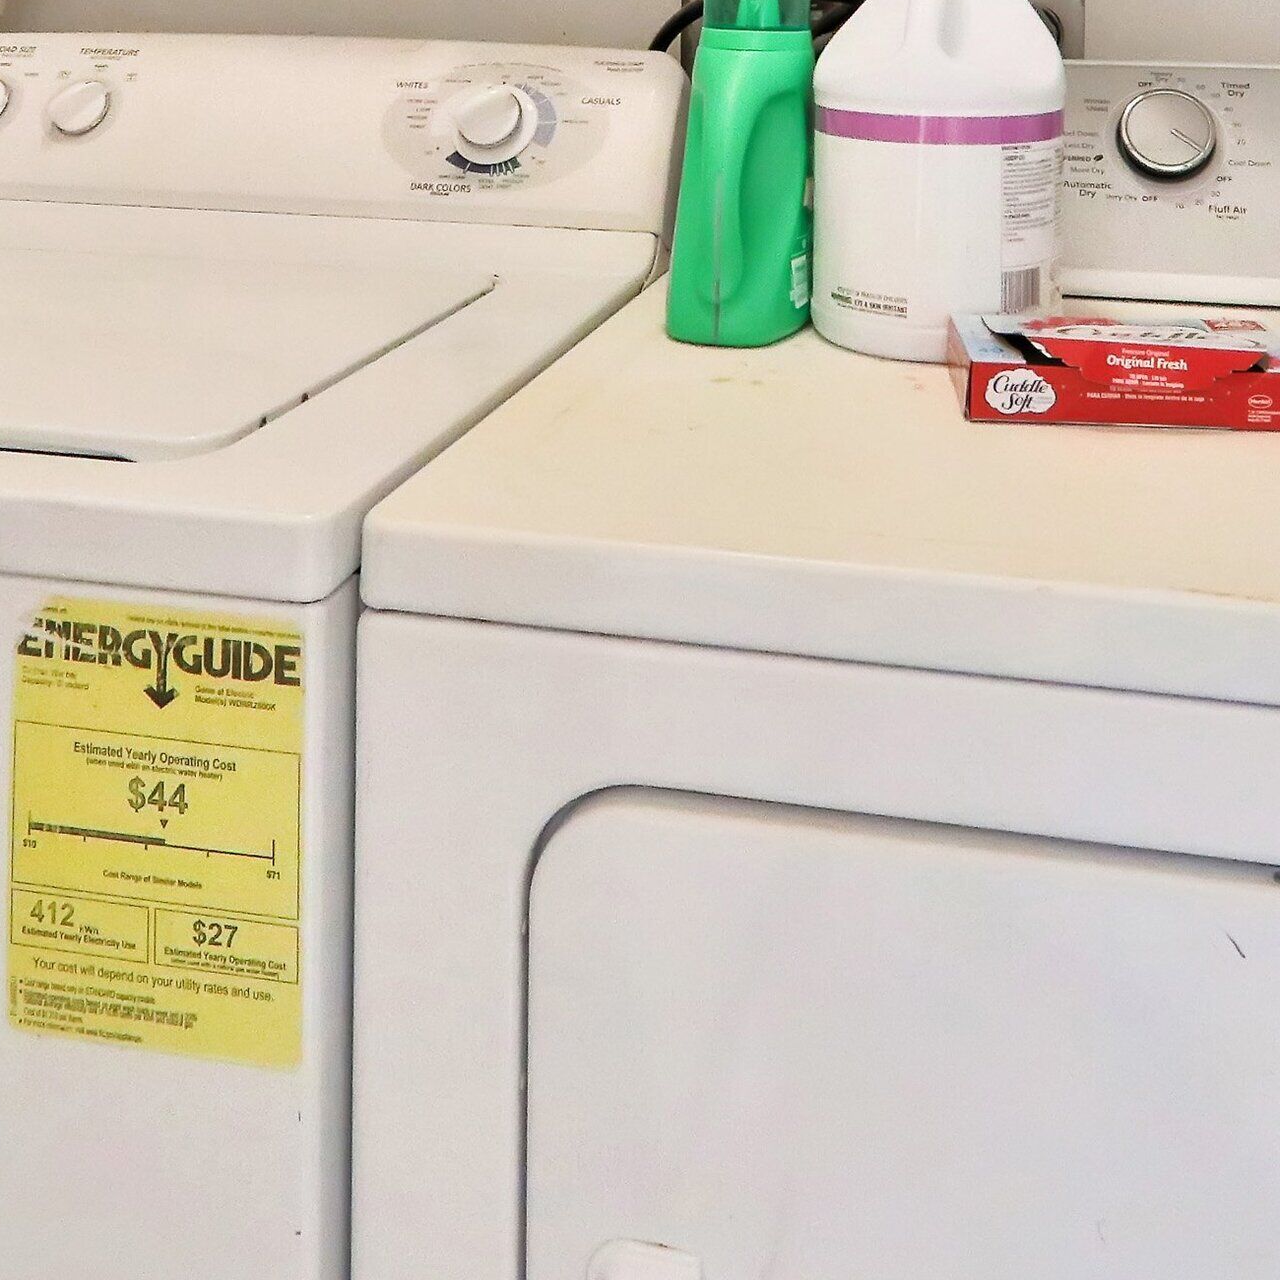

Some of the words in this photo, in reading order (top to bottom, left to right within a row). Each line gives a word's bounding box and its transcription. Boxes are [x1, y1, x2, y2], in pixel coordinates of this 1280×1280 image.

[79, 48, 140, 57] TEMPERATURE
[581, 97, 621, 105] CASUALS
[1227, 90, 1245, 98] Dry
[410, 182, 434, 191] DARK
[436, 183, 472, 193] COLORS
[1063, 181, 1112, 190] Automatic
[1079, 189, 1097, 198] Dry
[1208, 205, 1230, 214] Fluff
[1233, 206, 1248, 214] Air
[1106, 354, 1155, 369] Original
[1157, 358, 1188, 371] Fresh
[993, 375, 1049, 394] Cuddle
[1001, 393, 1033, 412] Soft
[17, 617, 301, 687] ENERGYGUIDE
[74, 742, 123, 758] Estimated
[125, 748, 157, 765] Yearly
[160, 752, 210, 770] Operating
[212, 759, 237, 771] Cost
[127, 775, 189, 815] $44
[22, 838, 37, 849] $10
[102, 869, 119, 879] Cost
[120, 871, 143, 883] Range
[144, 874, 152, 883] of
[177, 880, 203, 889] Models
[266, 870, 281, 880] $71
[30, 899, 75, 928] 412
[21, 925, 58, 939] Estimated
[60, 930, 82, 943] Yearly
[83, 935, 120, 949] Electricity
[122, 940, 136, 950] Use
[192, 918, 238, 948] $27
[164, 946, 202, 960] Estimated
[204, 952, 227, 964] Yearly
[229, 955, 266, 969] Operating
[268, 960, 287, 971] Cost
[32, 957, 56, 970] Your
[57, 962, 78, 974] cost
[80, 965, 96, 976] will
[97, 968, 134, 983] depend
[136, 974, 149, 984] on
[152, 978, 174, 989] your
[175, 979, 200, 994] utility
[203, 983, 229, 996] rates
[231, 986, 250, 999] and
[253, 991, 275, 1002] use.
